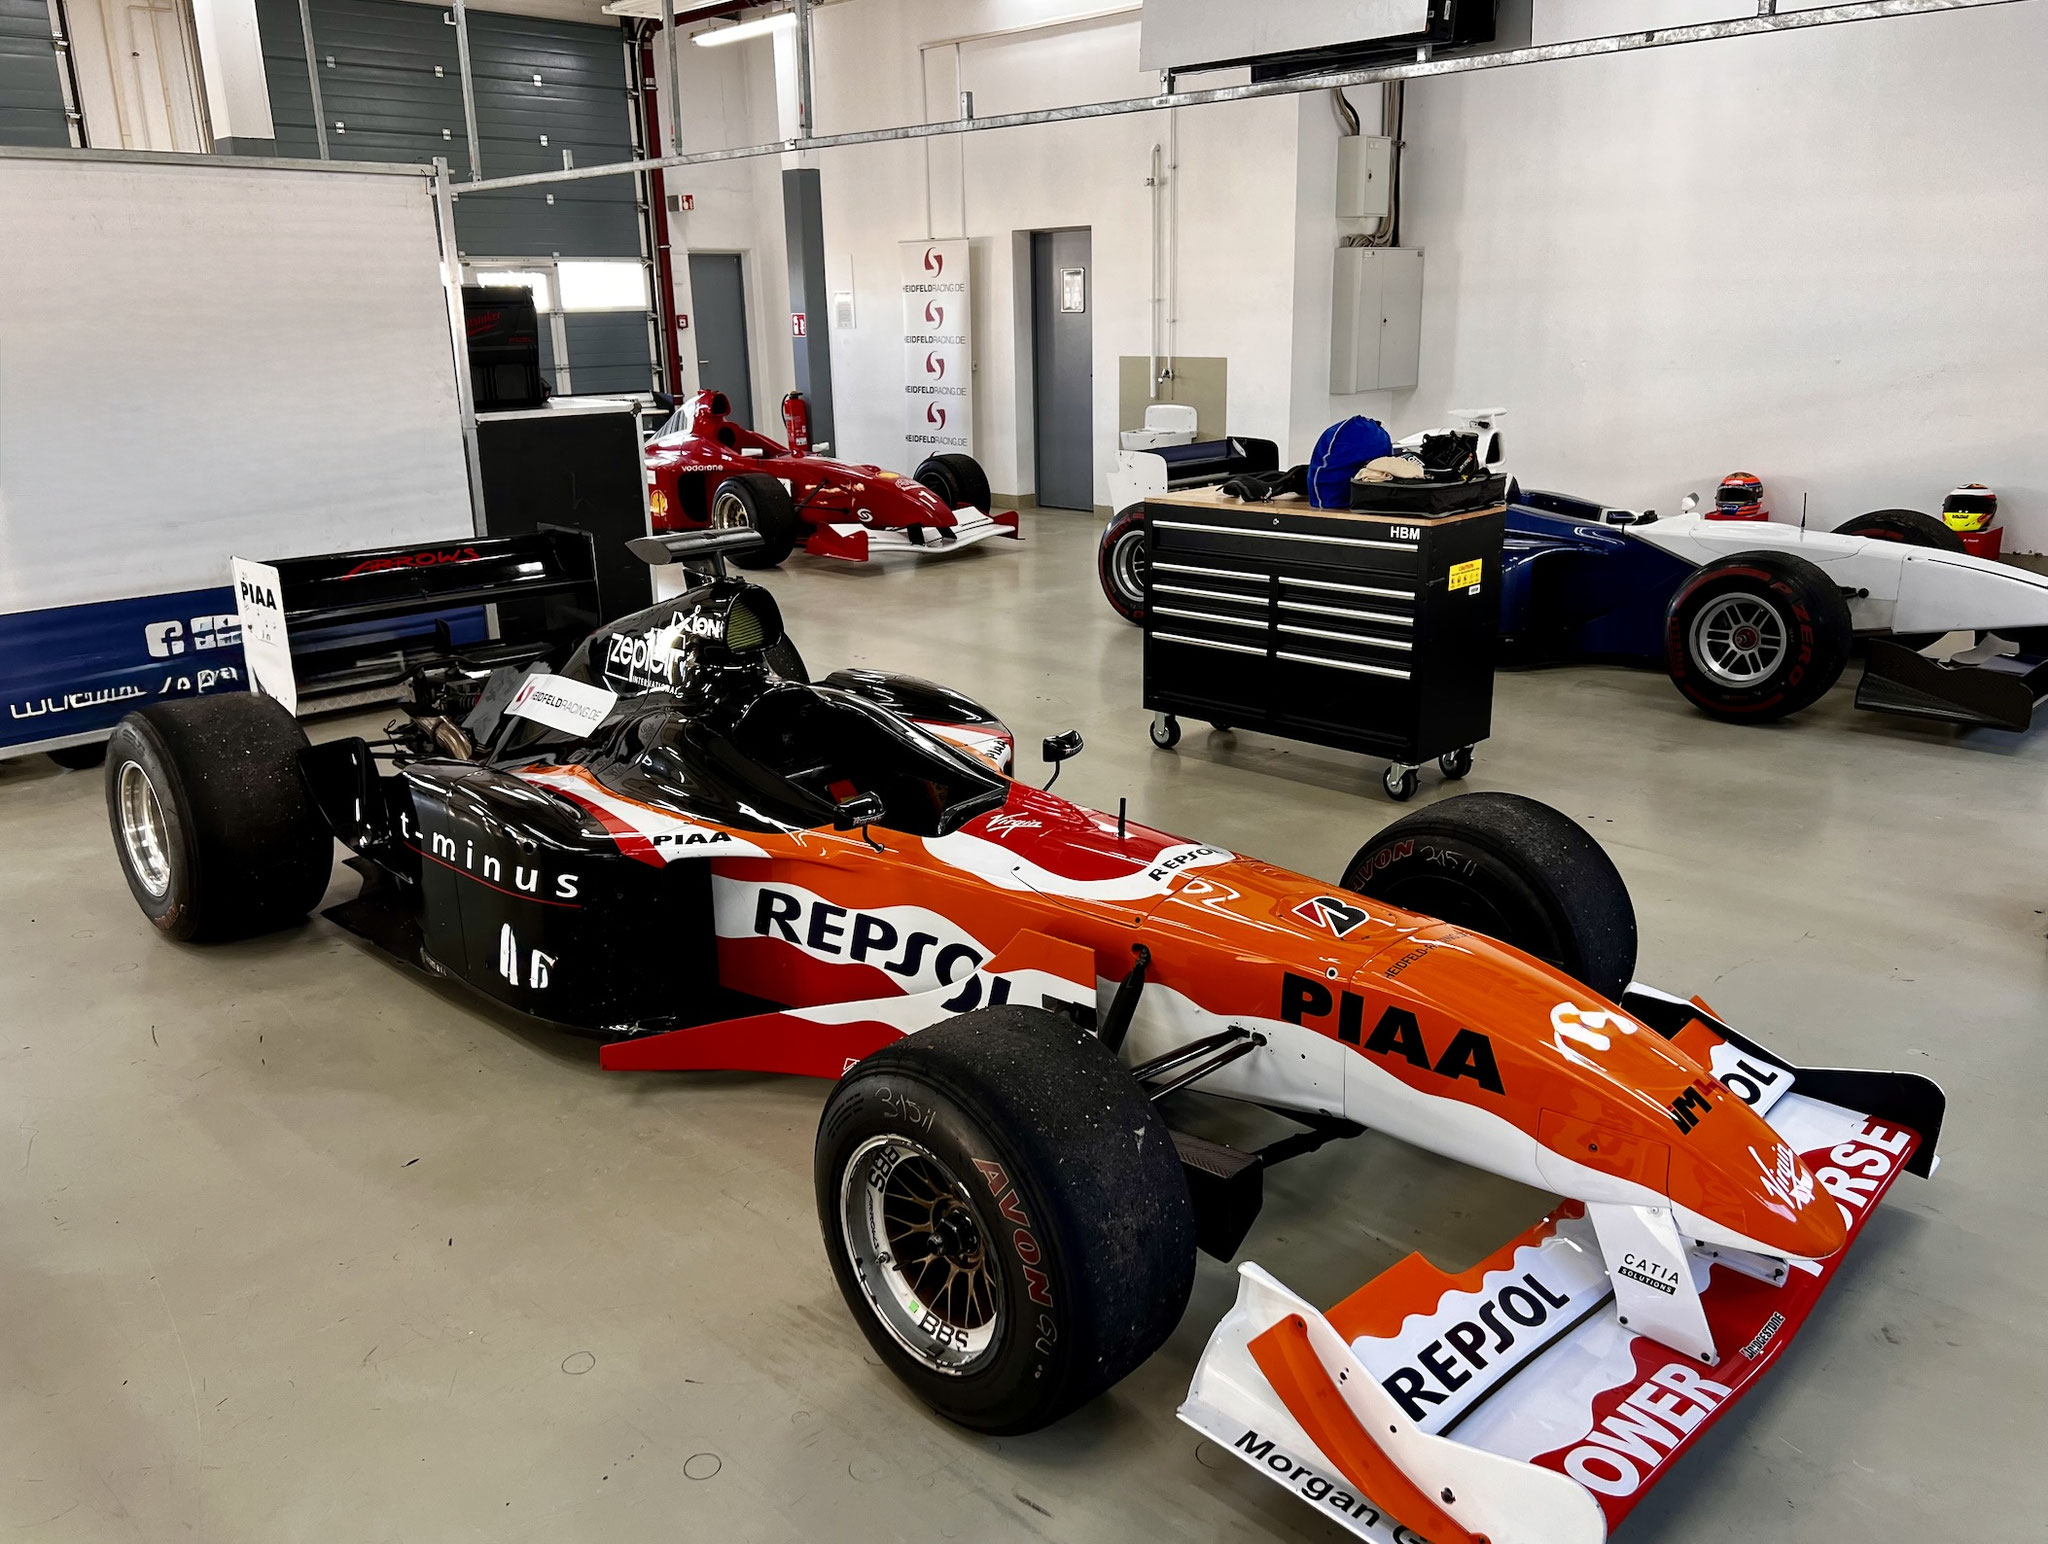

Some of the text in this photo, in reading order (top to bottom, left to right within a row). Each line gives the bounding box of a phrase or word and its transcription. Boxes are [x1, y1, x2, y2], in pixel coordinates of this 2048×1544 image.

[1390, 525, 1421, 540] HBM
[341, 547, 480, 581] ARROWS
[240, 581, 277, 610] PIAA
[987, 740, 1007, 760] PIAA
[652, 831, 733, 846] PIAA
[986, 812, 1042, 838] Virgin
[1280, 971, 1506, 1096] PIAA
[868, 1146, 901, 1194] BBS
[1748, 1142, 1816, 1211] Virgin
[971, 1157, 1054, 1309] AVON
[1620, 1268, 1673, 1294] SOLUTIONS
[1624, 1253, 1679, 1285] CATIA
[918, 1310, 969, 1351] BBS
[1381, 1272, 1571, 1423] REPSOL
[1739, 1311, 1786, 1361] BRIDGESTONE
[1563, 1363, 1733, 1497] OWER
[1234, 1430, 1381, 1529] Morgan
